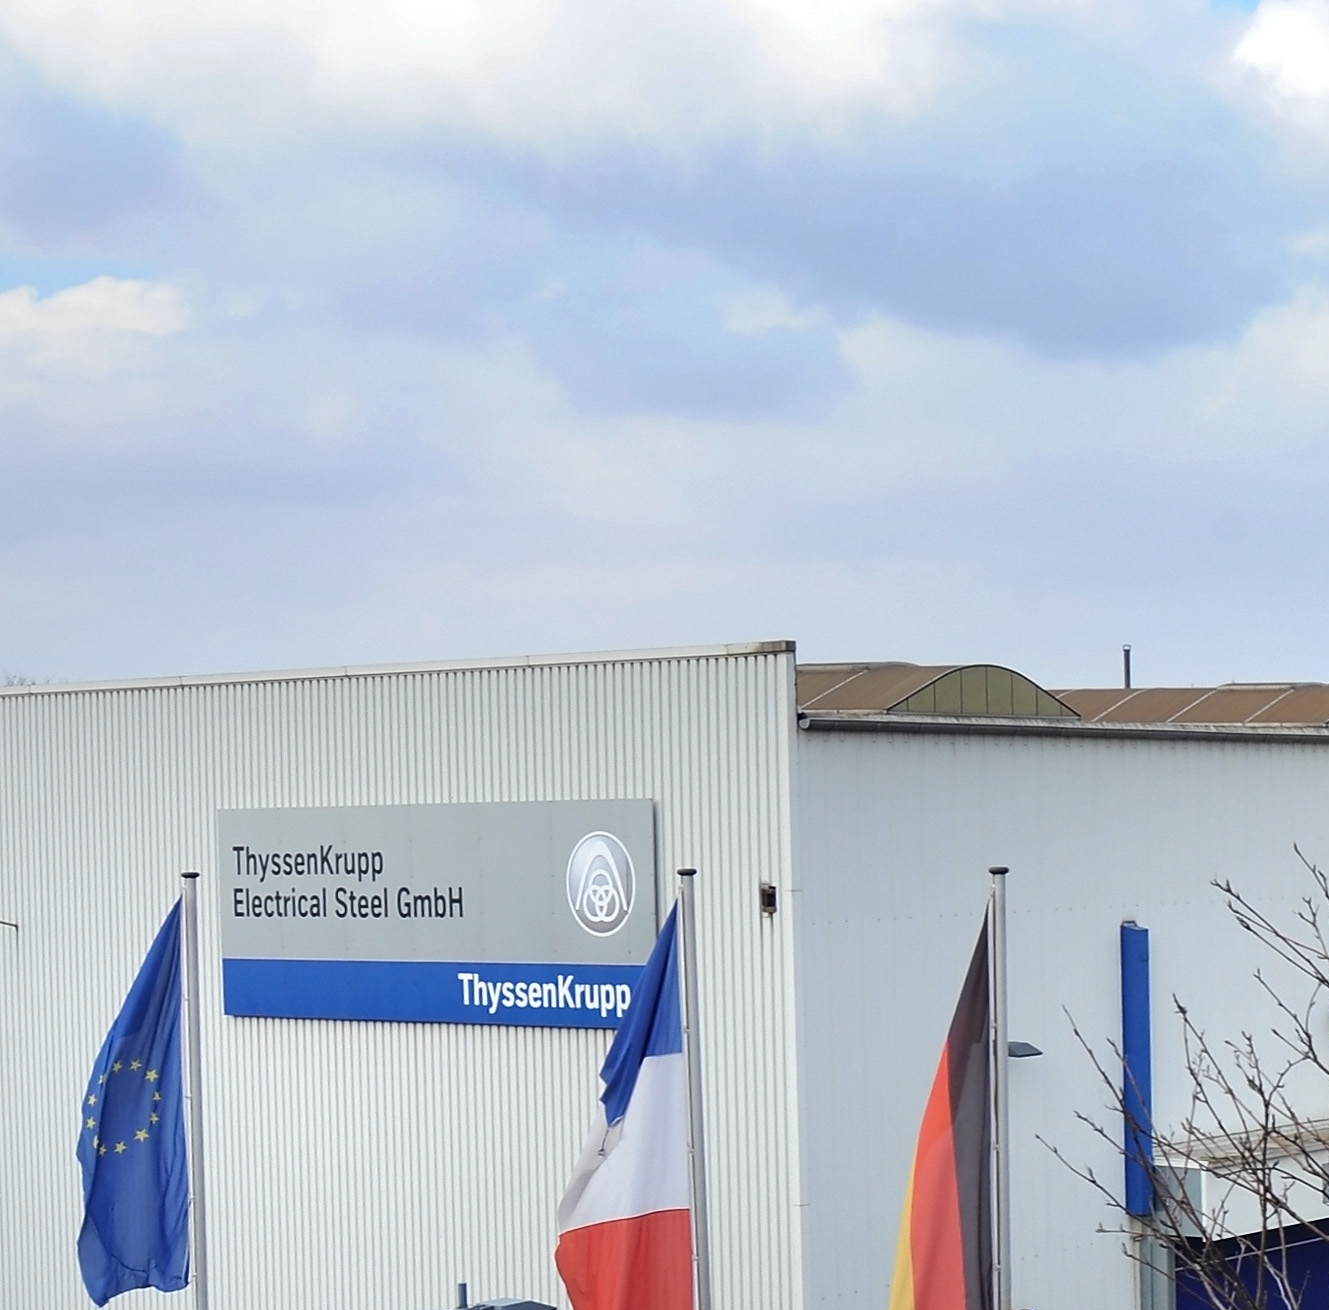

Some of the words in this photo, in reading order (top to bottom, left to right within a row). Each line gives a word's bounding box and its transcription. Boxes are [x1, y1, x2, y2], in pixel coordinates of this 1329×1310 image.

[233, 844, 384, 882] ThyssenKrupp
[233, 887, 327, 918] Electrical
[335, 886, 389, 918] Steel
[396, 886, 464, 918] GmbH
[457, 972, 632, 1018] ThyssenKrupp
